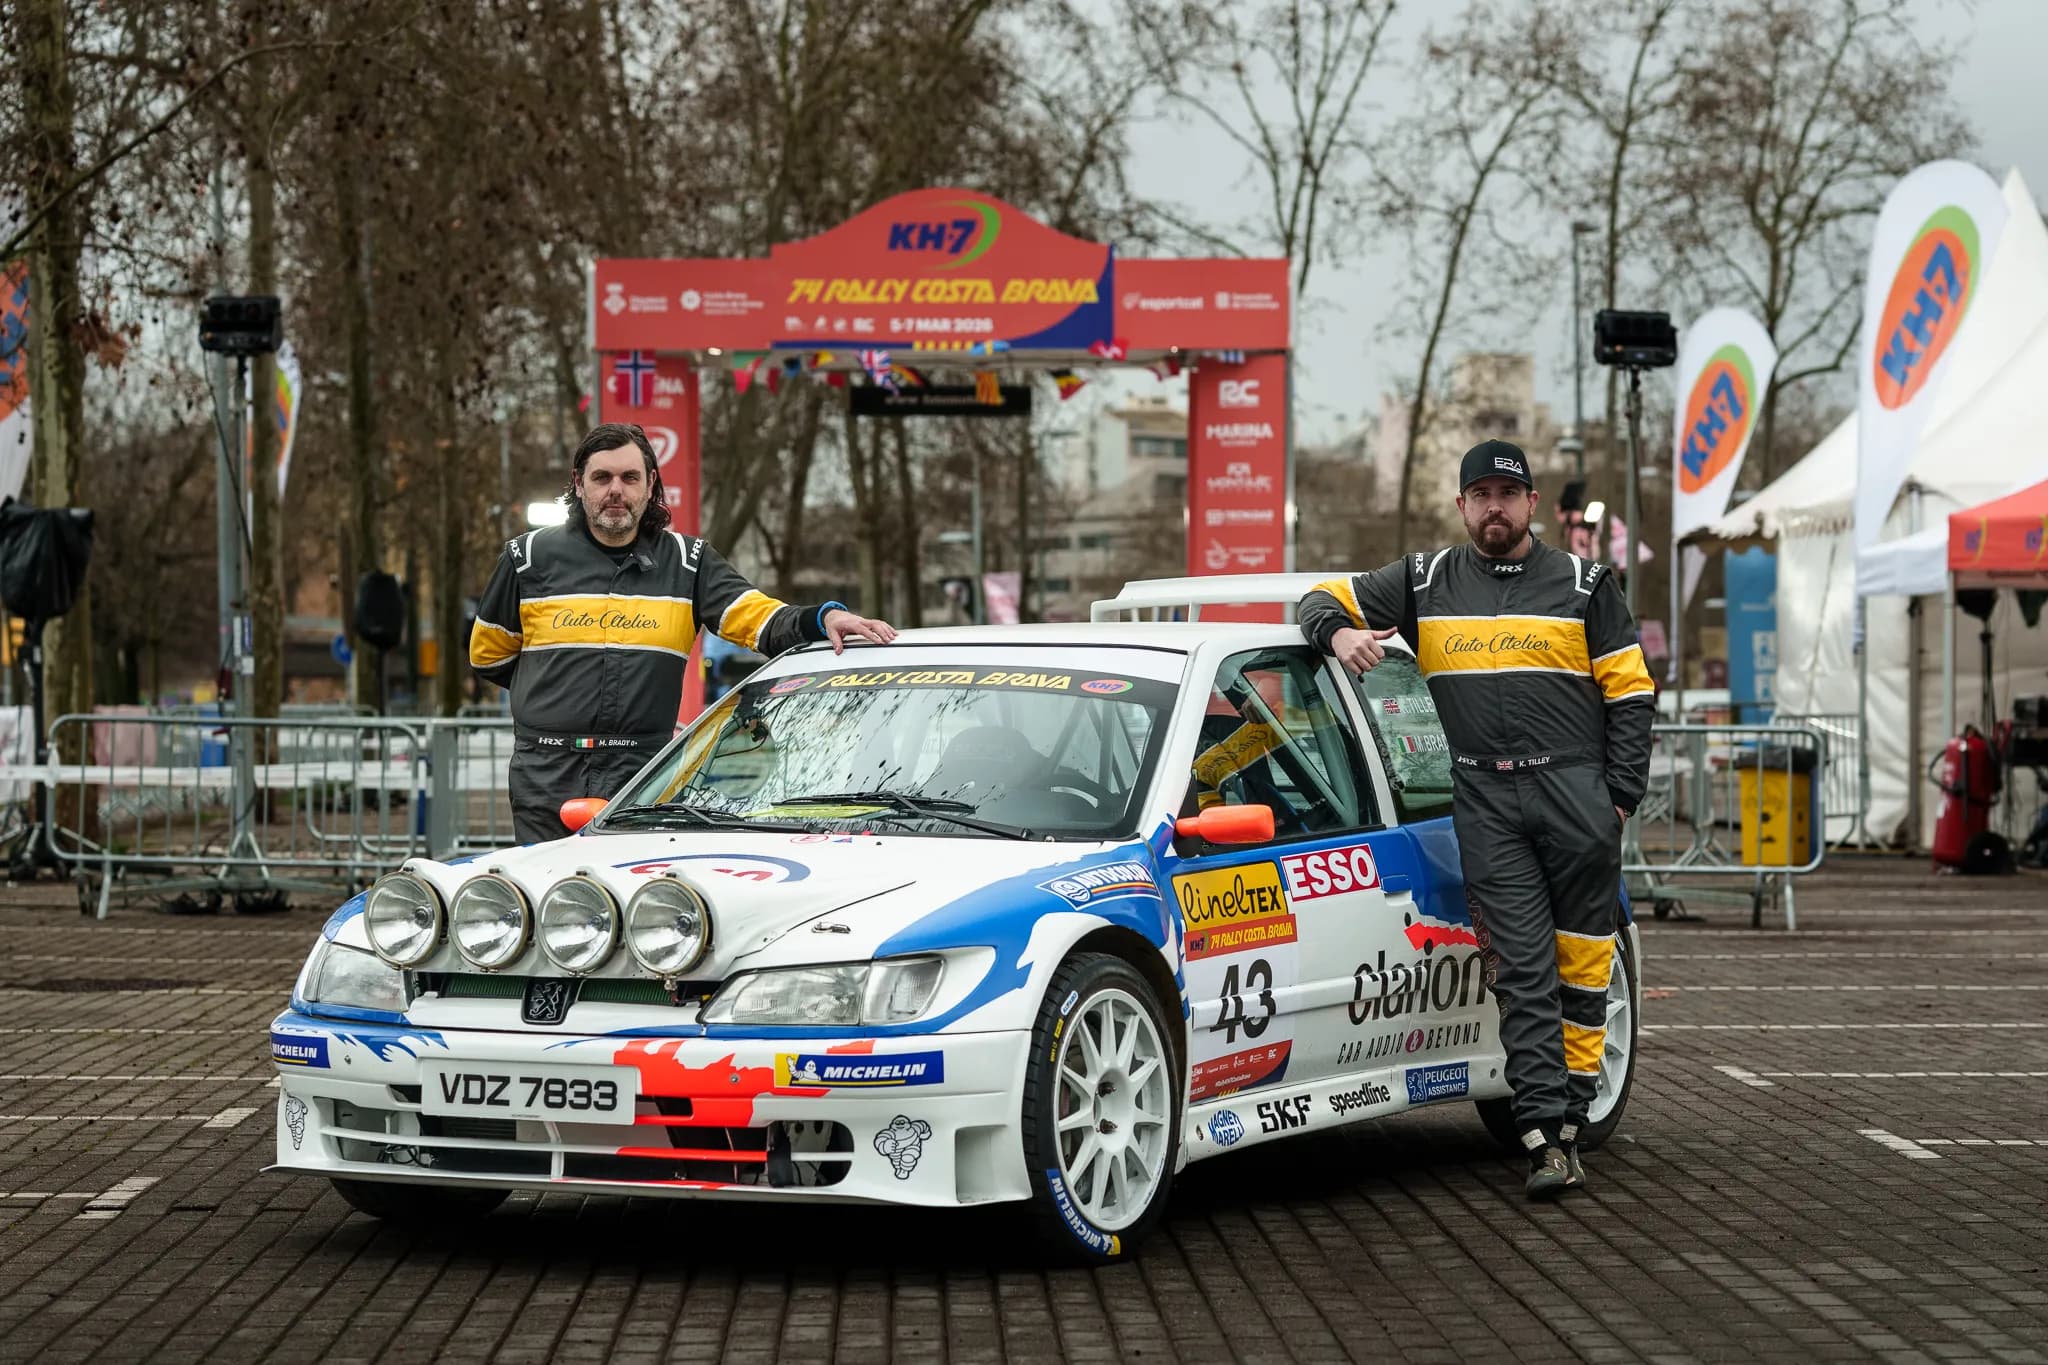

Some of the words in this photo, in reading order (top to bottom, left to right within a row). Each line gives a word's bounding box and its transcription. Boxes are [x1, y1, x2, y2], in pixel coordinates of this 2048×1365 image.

[787, 278, 823, 303] 74
[823, 278, 910, 303] RALLY
[910, 278, 997, 303] COSTA
[1000, 278, 1099, 303] BRAVA
[1494, 457, 1523, 471] ERA
[1494, 563, 1525, 573] HRX
[1585, 562, 1603, 583] HRX
[599, 609, 661, 630] Atelier
[1488, 631, 1552, 654] Atelier
[816, 672, 903, 688] RALLY
[897, 671, 976, 685] COSTA
[976, 672, 1072, 690] BRAVA
[538, 737, 564, 746] HRX
[1528, 756, 1550, 766] TILLEY
[1283, 848, 1376, 898] ESSO
[1210, 934, 1221, 950] 74
[1220, 929, 1244, 948] RALLY
[1244, 926, 1267, 943] COSTA
[1267, 921, 1293, 939] BRAVA
[1348, 938, 1488, 1026] clarion
[1209, 958, 1276, 1044] 43
[1337, 1040, 1363, 1065] CAR
[1365, 1032, 1404, 1060] AUDIO
[1425, 1021, 1481, 1050] BEYOND
[823, 1063, 927, 1079] MICHELIN
[1424, 1066, 1468, 1084] PEUGEOT
[439, 1072, 511, 1107] VDZ
[518, 1076, 619, 1112] 7833
[1328, 1081, 1392, 1117] speedline
[1427, 1082, 1467, 1097] ASSISTANCE
[1256, 1094, 1313, 1134] SKF
[1051, 1176, 1102, 1248] MICHELIN
